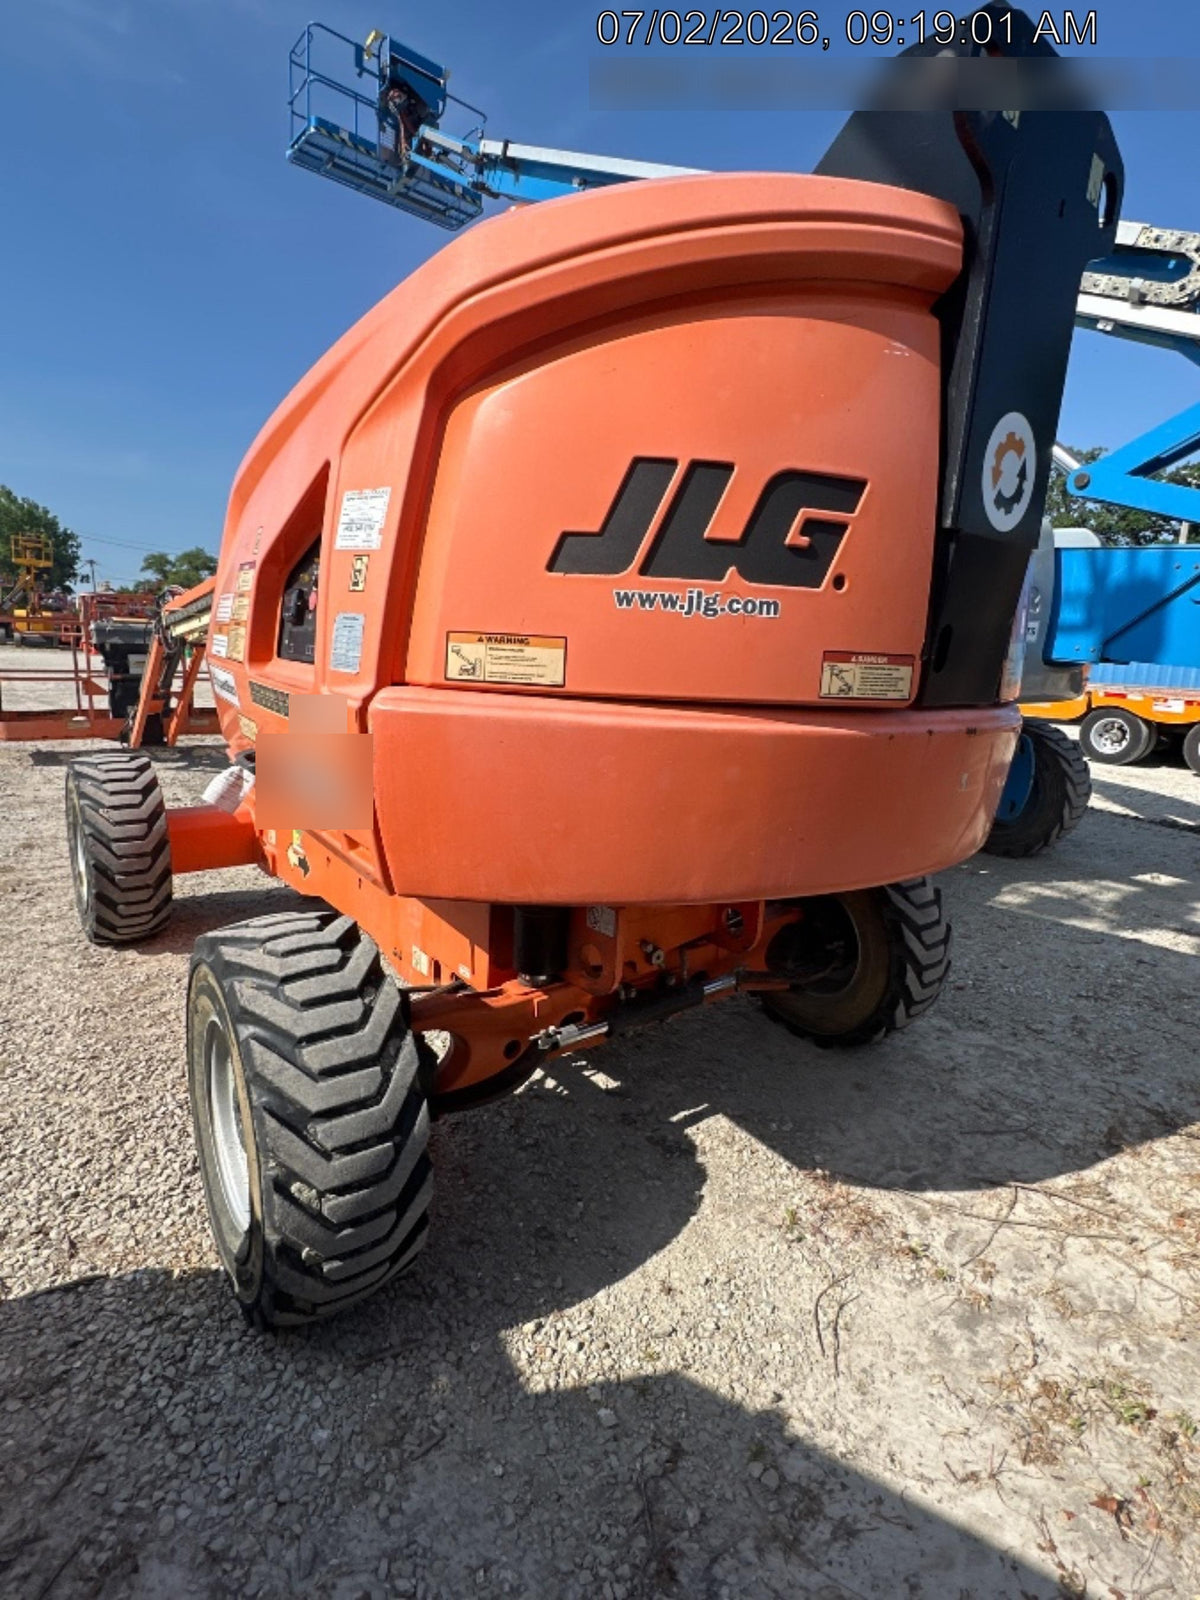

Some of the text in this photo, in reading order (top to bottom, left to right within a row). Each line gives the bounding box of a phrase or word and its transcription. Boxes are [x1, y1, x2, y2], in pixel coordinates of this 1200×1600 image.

[545, 456, 870, 591] JLG
[614, 588, 780, 618] www.jlg.com
[485, 635, 531, 646] WARNING
